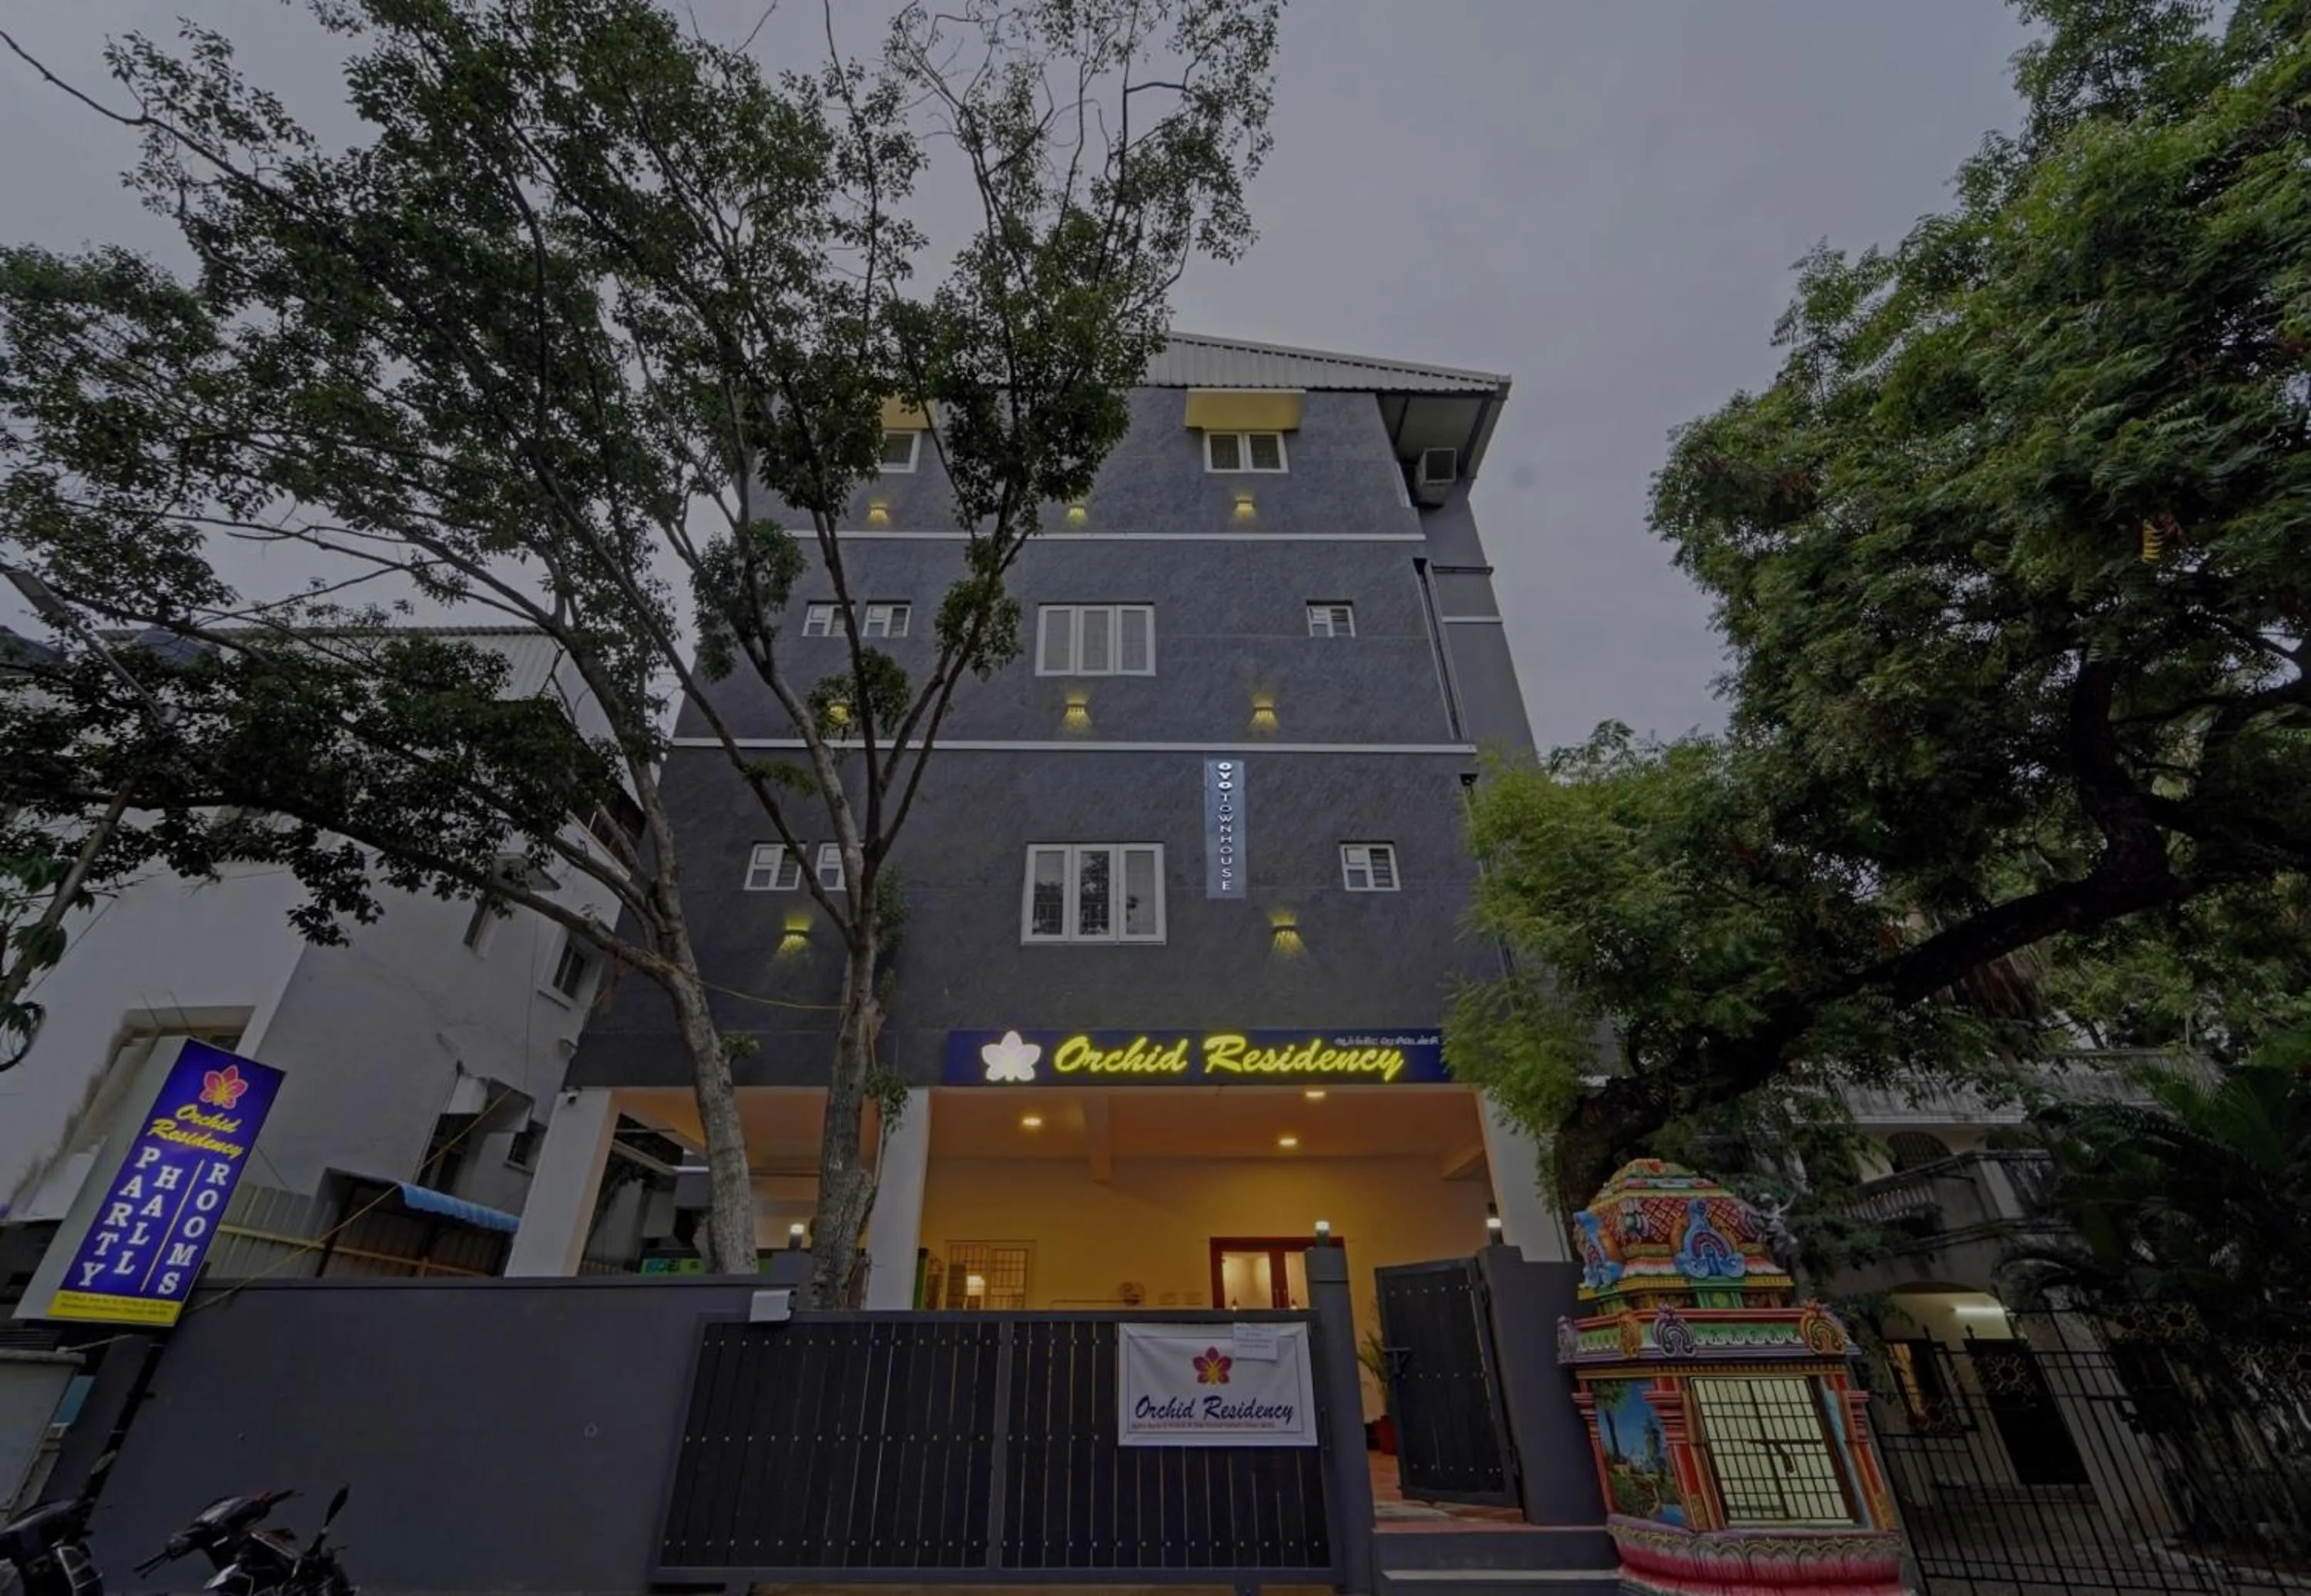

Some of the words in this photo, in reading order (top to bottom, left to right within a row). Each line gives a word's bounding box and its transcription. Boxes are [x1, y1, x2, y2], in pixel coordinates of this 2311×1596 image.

[1218, 762, 1233, 790] OYO
[1218, 793, 1233, 891] TOWNHOUSE
[1054, 1034, 1189, 1074] Orchid
[1204, 1035, 1404, 1081] Residency
[147, 1119, 243, 1158] Residency
[176, 1104, 241, 1133] Orchid
[79, 1146, 160, 1288] PARTY
[113, 1165, 183, 1275] HALL
[159, 1164, 230, 1296] ROOMS
[1135, 1395, 1196, 1420] Orchid
[1203, 1395, 1293, 1423] Residency
